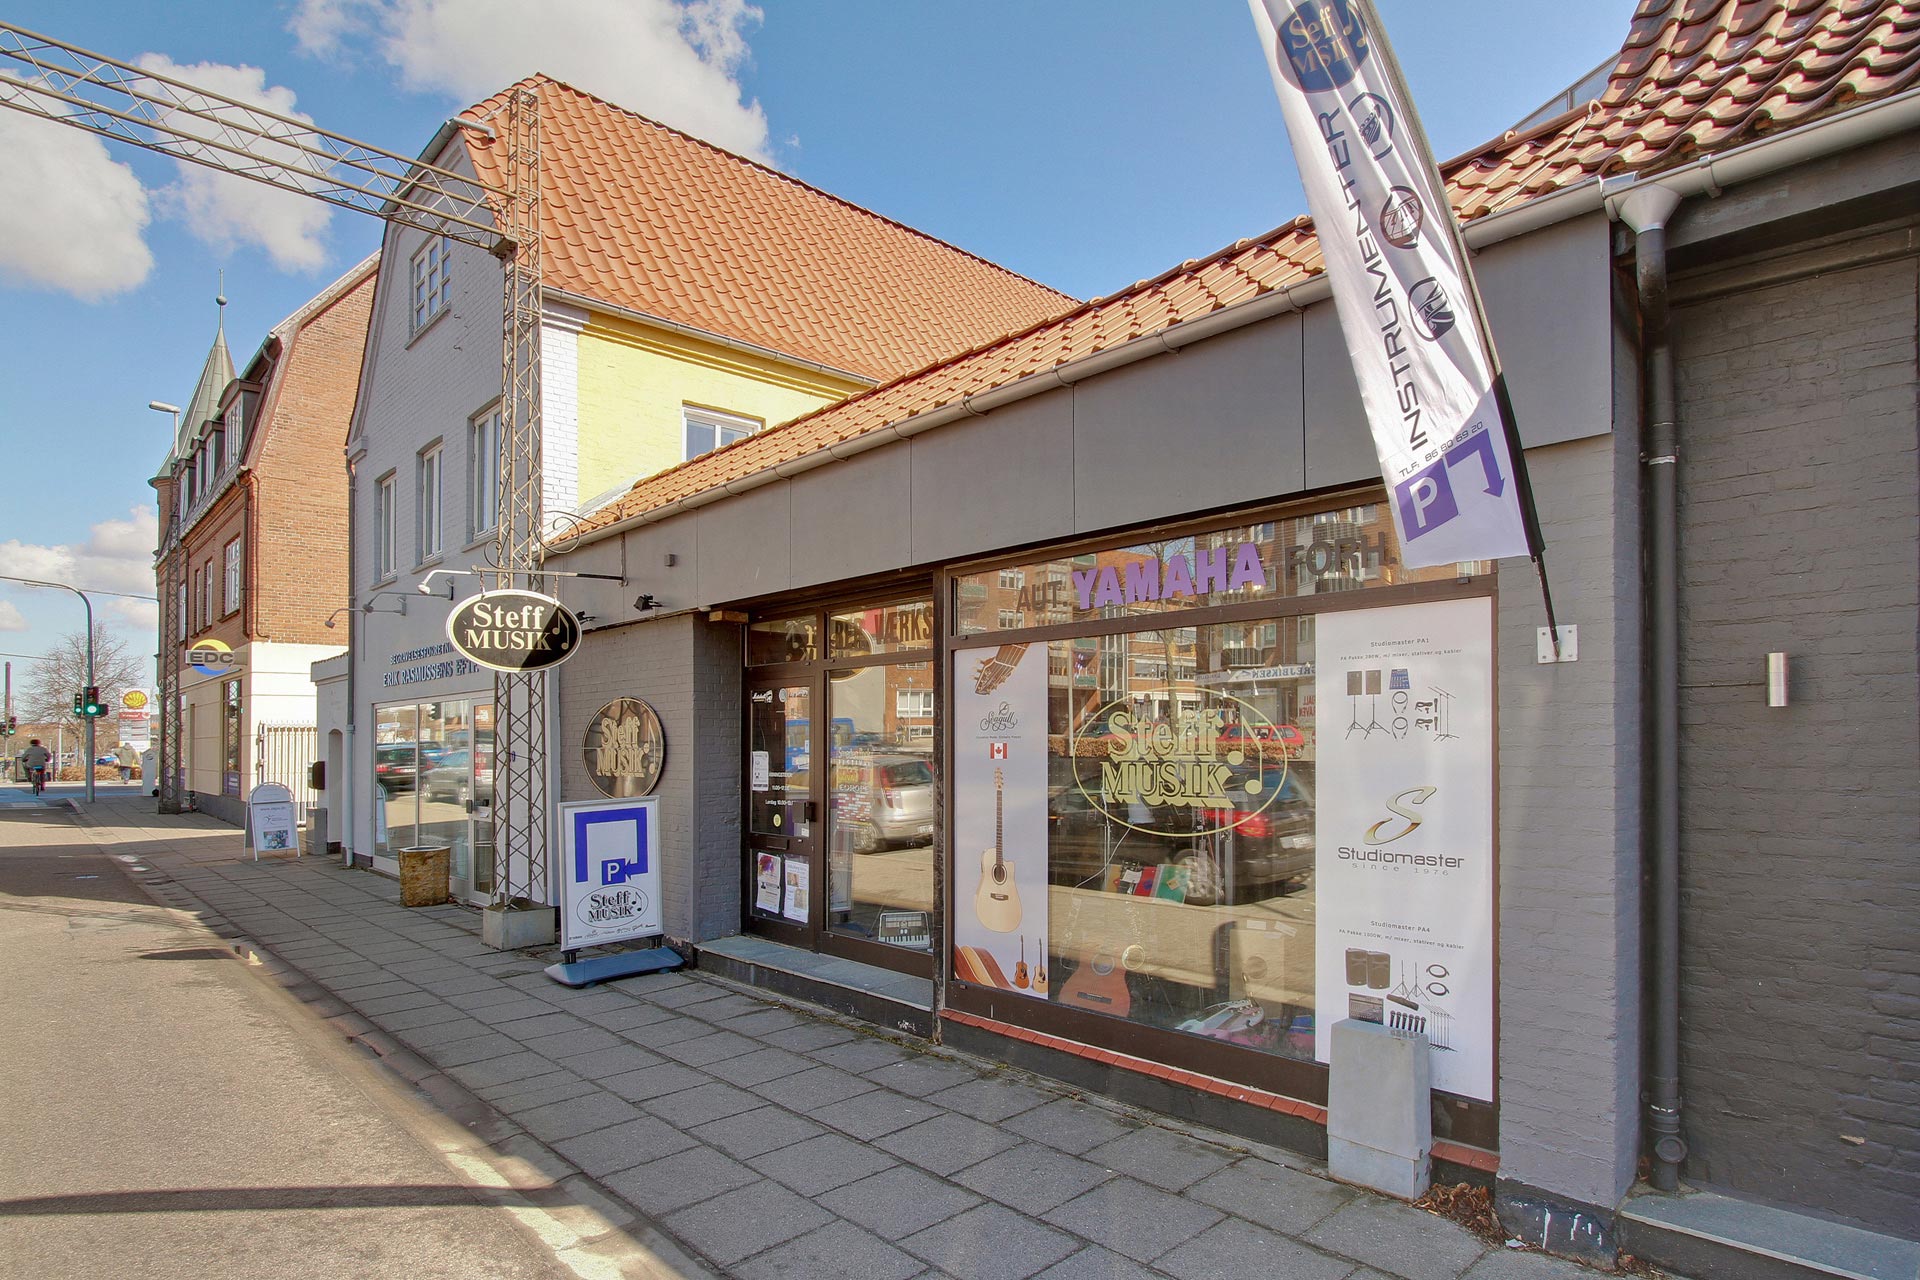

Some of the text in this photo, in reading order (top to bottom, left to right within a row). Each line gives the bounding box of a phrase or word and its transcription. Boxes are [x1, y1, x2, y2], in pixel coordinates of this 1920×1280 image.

[1318, 107, 1429, 451] INSTRUMENTER
[1424, 449, 1439, 462] 86
[1471, 421, 1483, 433] 20
[1408, 476, 1438, 529] P
[1016, 531, 1398, 613] AUT. YAMAHA FORH.
[473, 602, 545, 630] Steff
[465, 629, 552, 651] MUSIK
[1370, 639, 1415, 647] Studiomaster
[190, 651, 234, 664] EDC
[383, 669, 400, 688] ERIK
[401, 660, 454, 685] RASMUSSENS
[601, 716, 640, 748] Steff
[980, 710, 1019, 732] Seagull
[1107, 709, 1222, 764] Steff
[596, 747, 645, 778] MUSIK
[1101, 761, 1233, 807] MUSIK
[1338, 846, 1465, 869] Studiomaster
[1352, 862, 1449, 876] since 1976
[607, 862, 620, 882] P
[590, 890, 632, 911] Steff
[588, 905, 635, 922] MUSIK
[1370, 920, 1415, 931] Studiomaster
